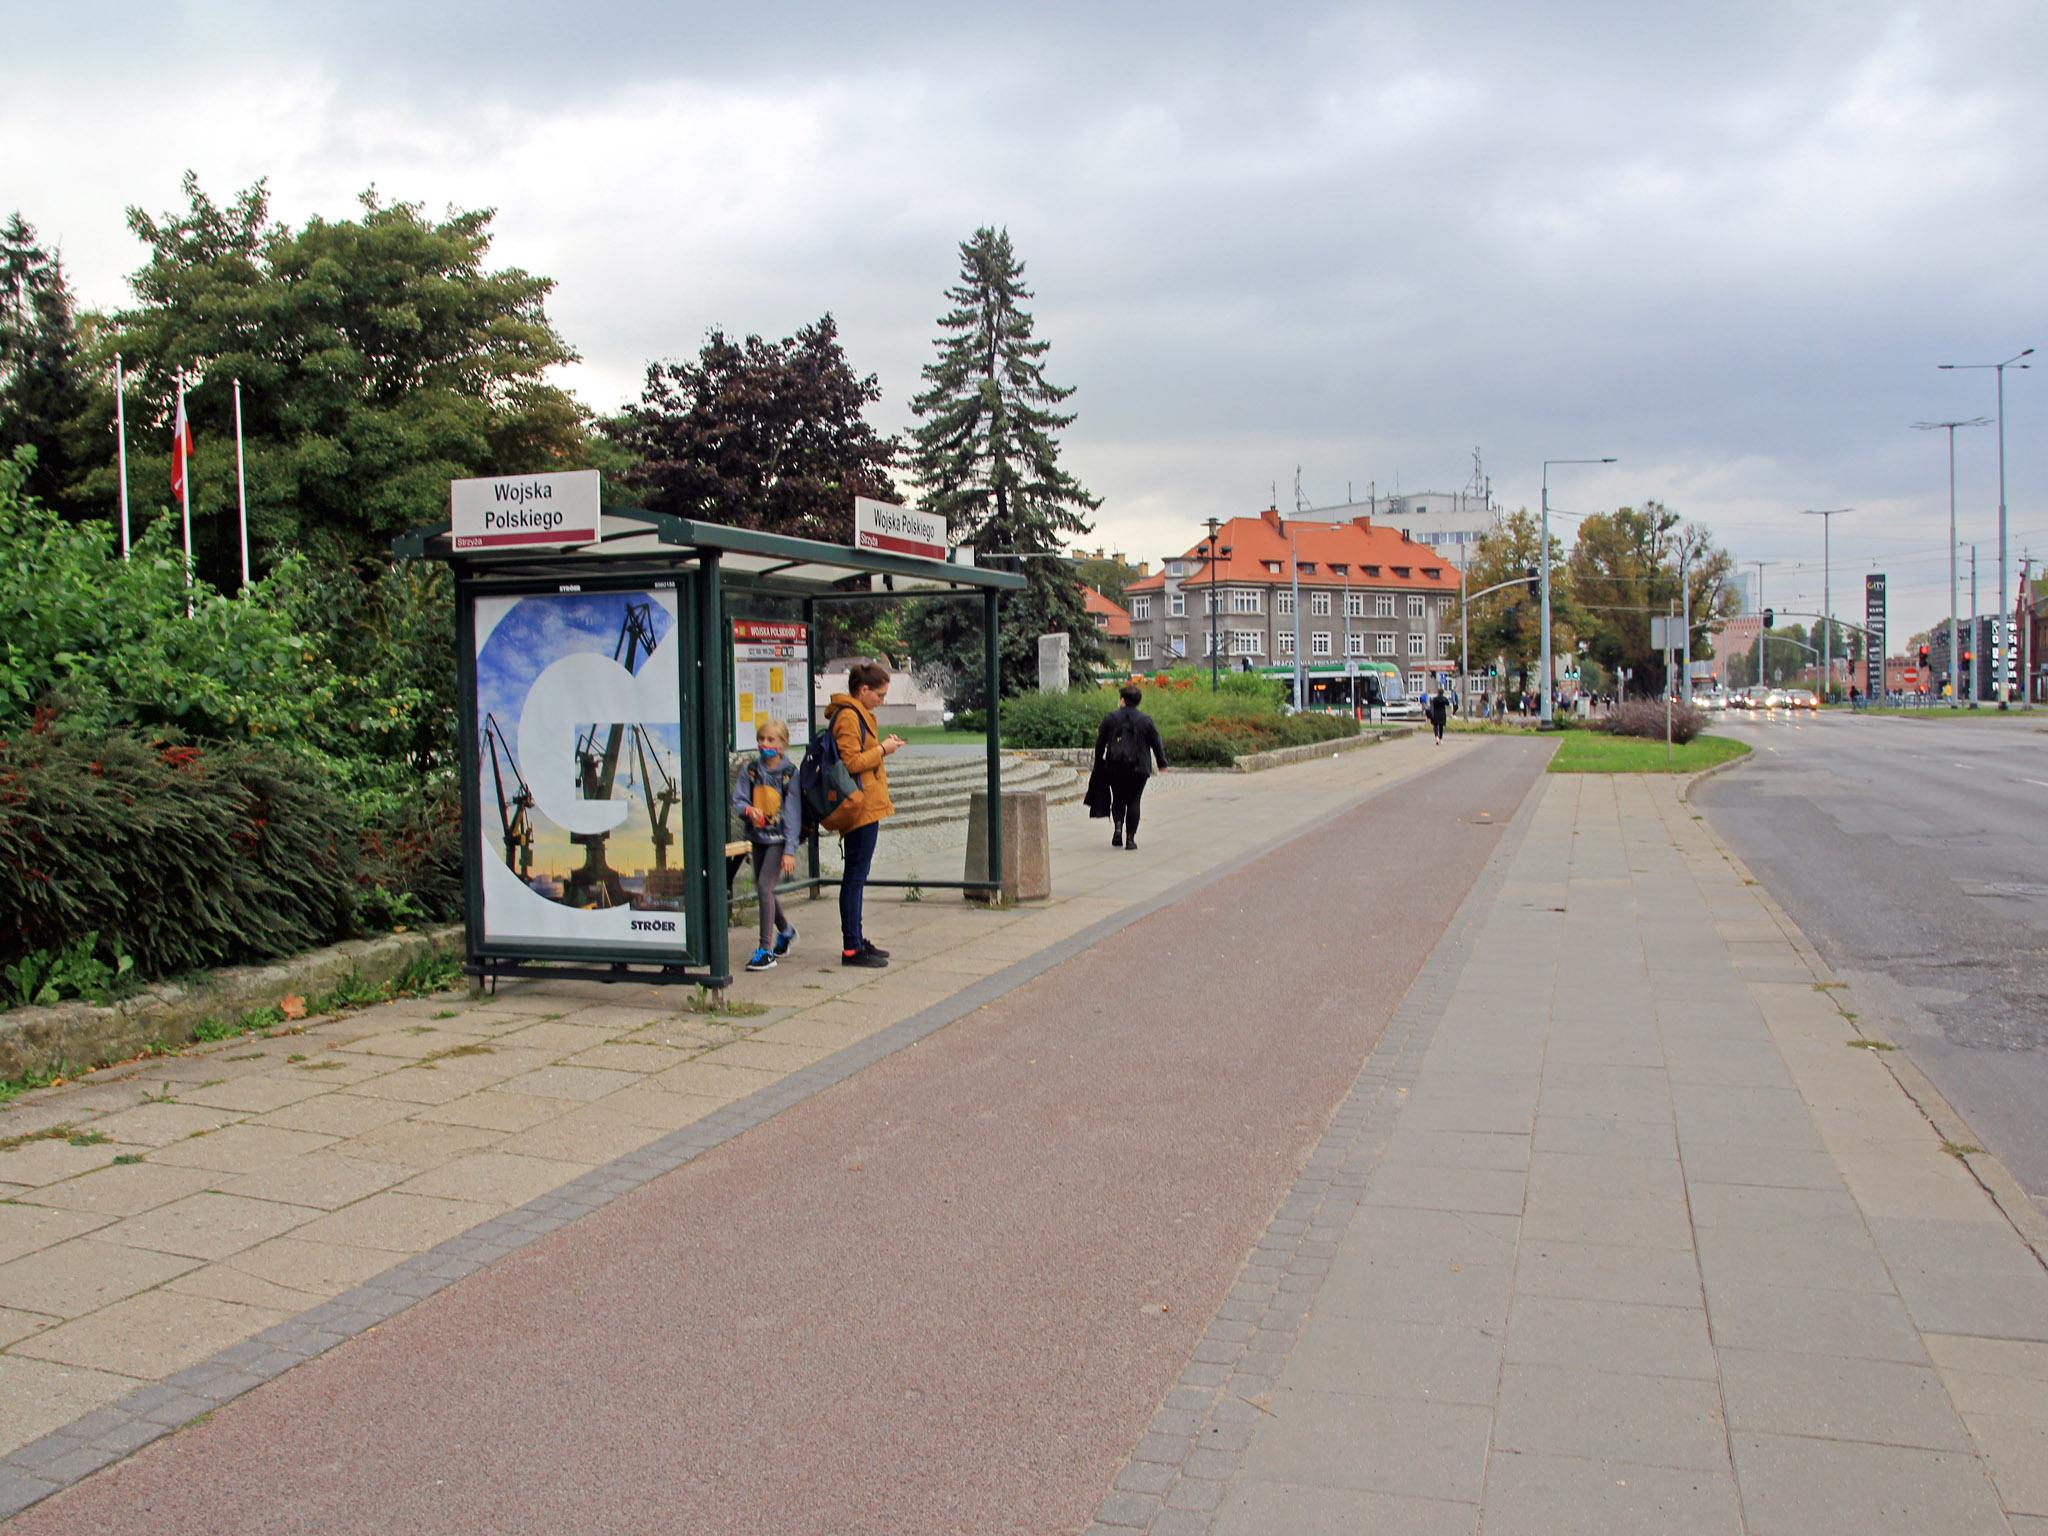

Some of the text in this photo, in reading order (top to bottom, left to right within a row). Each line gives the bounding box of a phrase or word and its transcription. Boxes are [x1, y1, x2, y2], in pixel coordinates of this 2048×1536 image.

[494, 481, 552, 505] Wojska
[485, 509, 563, 530] Polskiego
[873, 507, 935, 542] Wojska Polskiego
[630, 919, 676, 932] STRÖER
